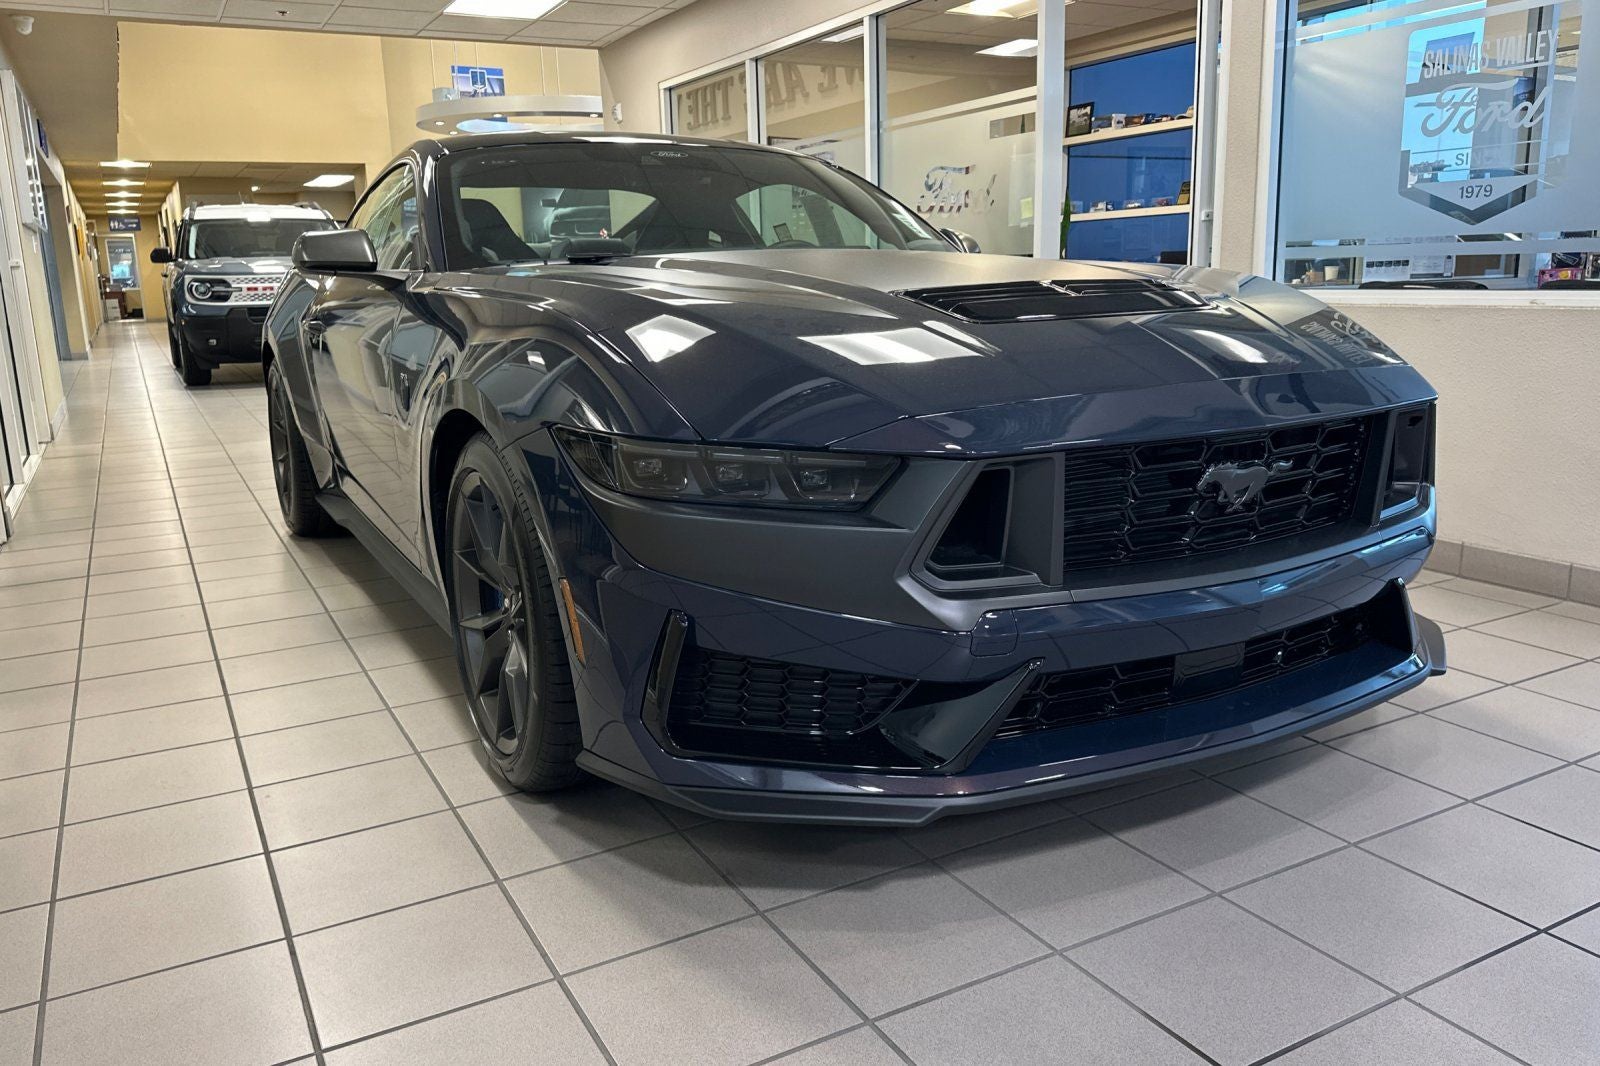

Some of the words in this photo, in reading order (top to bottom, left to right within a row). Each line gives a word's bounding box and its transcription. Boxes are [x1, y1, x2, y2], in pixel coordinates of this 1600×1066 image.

[1424, 41, 1489, 79] SALINAS
[1496, 29, 1559, 67] VALLEY
[1414, 78, 1549, 138] Ford
[1459, 184, 1493, 199] 1979
